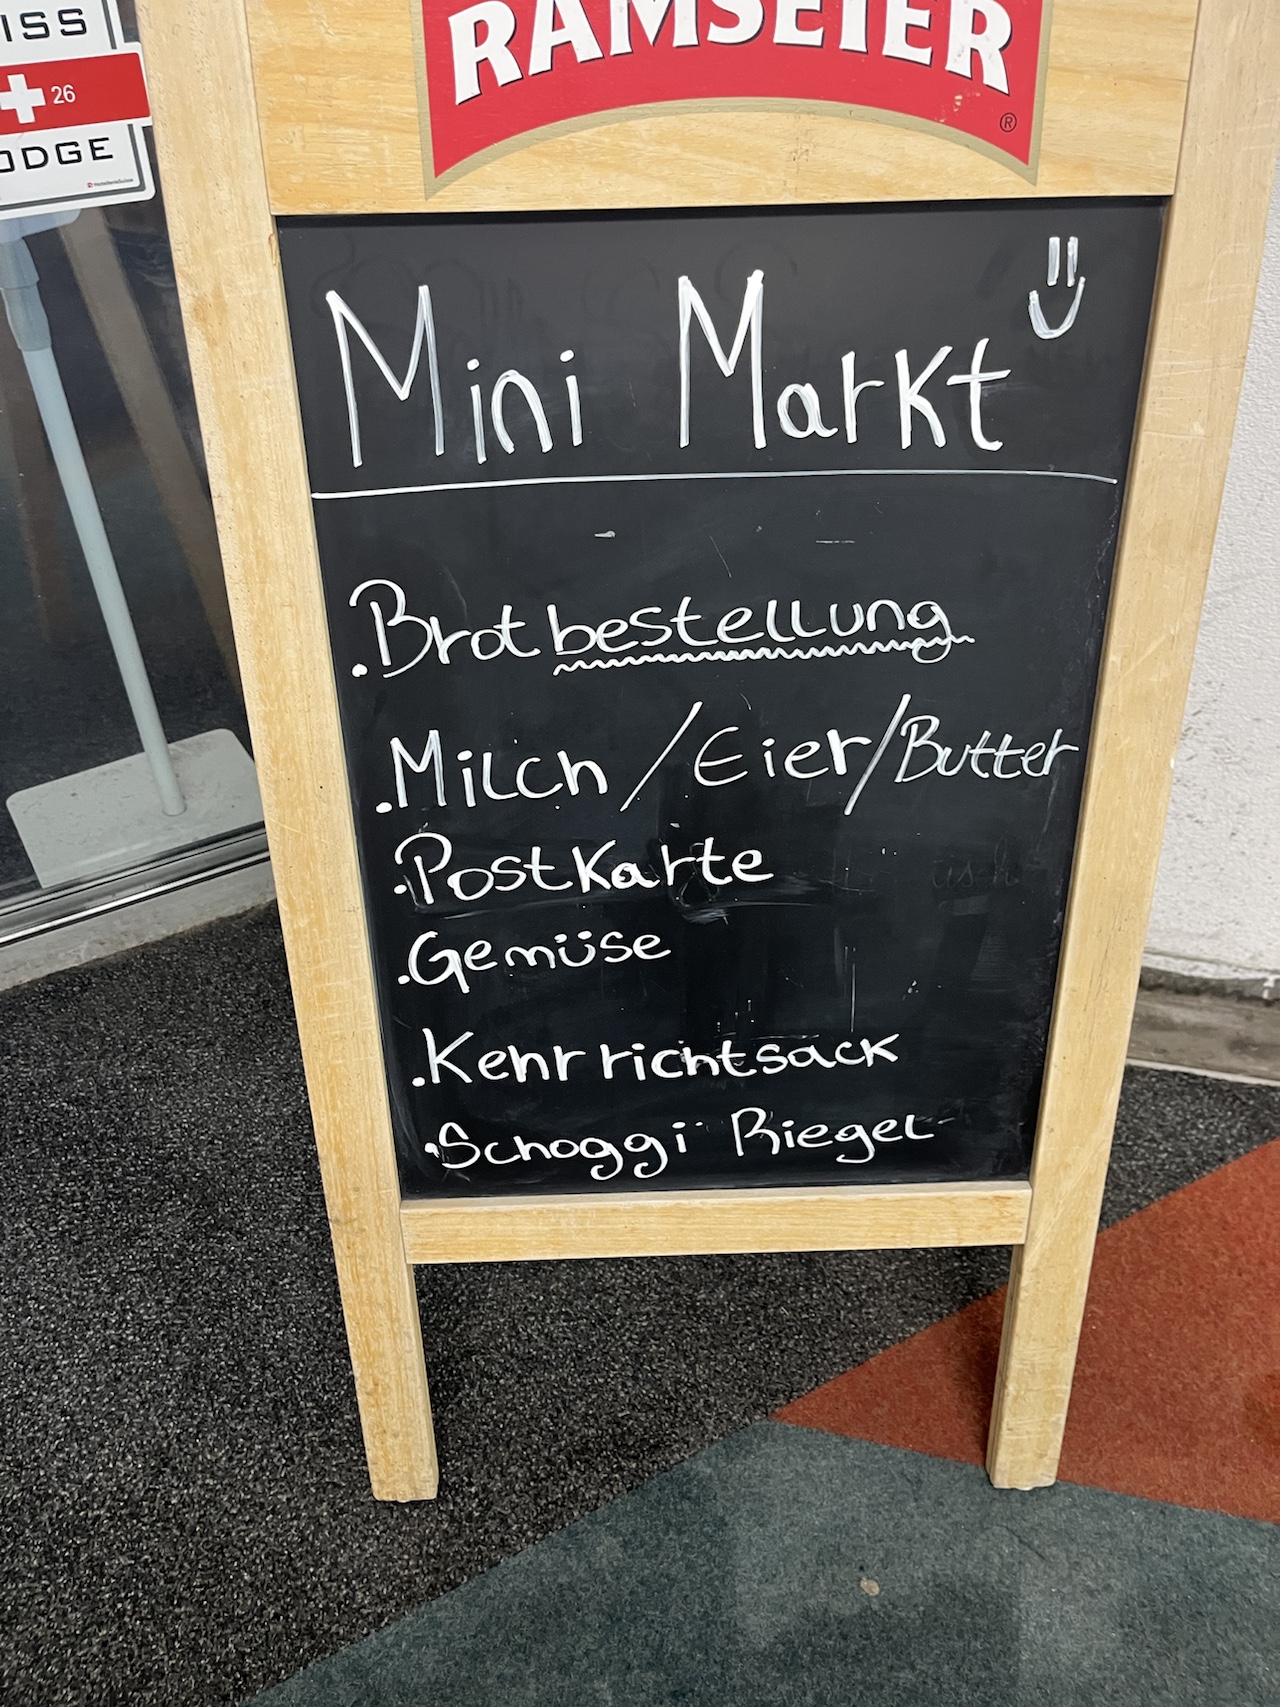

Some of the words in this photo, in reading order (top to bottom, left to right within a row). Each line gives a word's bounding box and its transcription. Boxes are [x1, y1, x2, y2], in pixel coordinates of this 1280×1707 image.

[448, 0, 1013, 105] RAMSEIER
[51, 84, 76, 105] 26
[326, 285, 582, 467] Mini
[408, 930, 672, 994] Gemüse
[437, 1121, 687, 1181] Schoggi
[730, 1107, 936, 1164] Riegel
